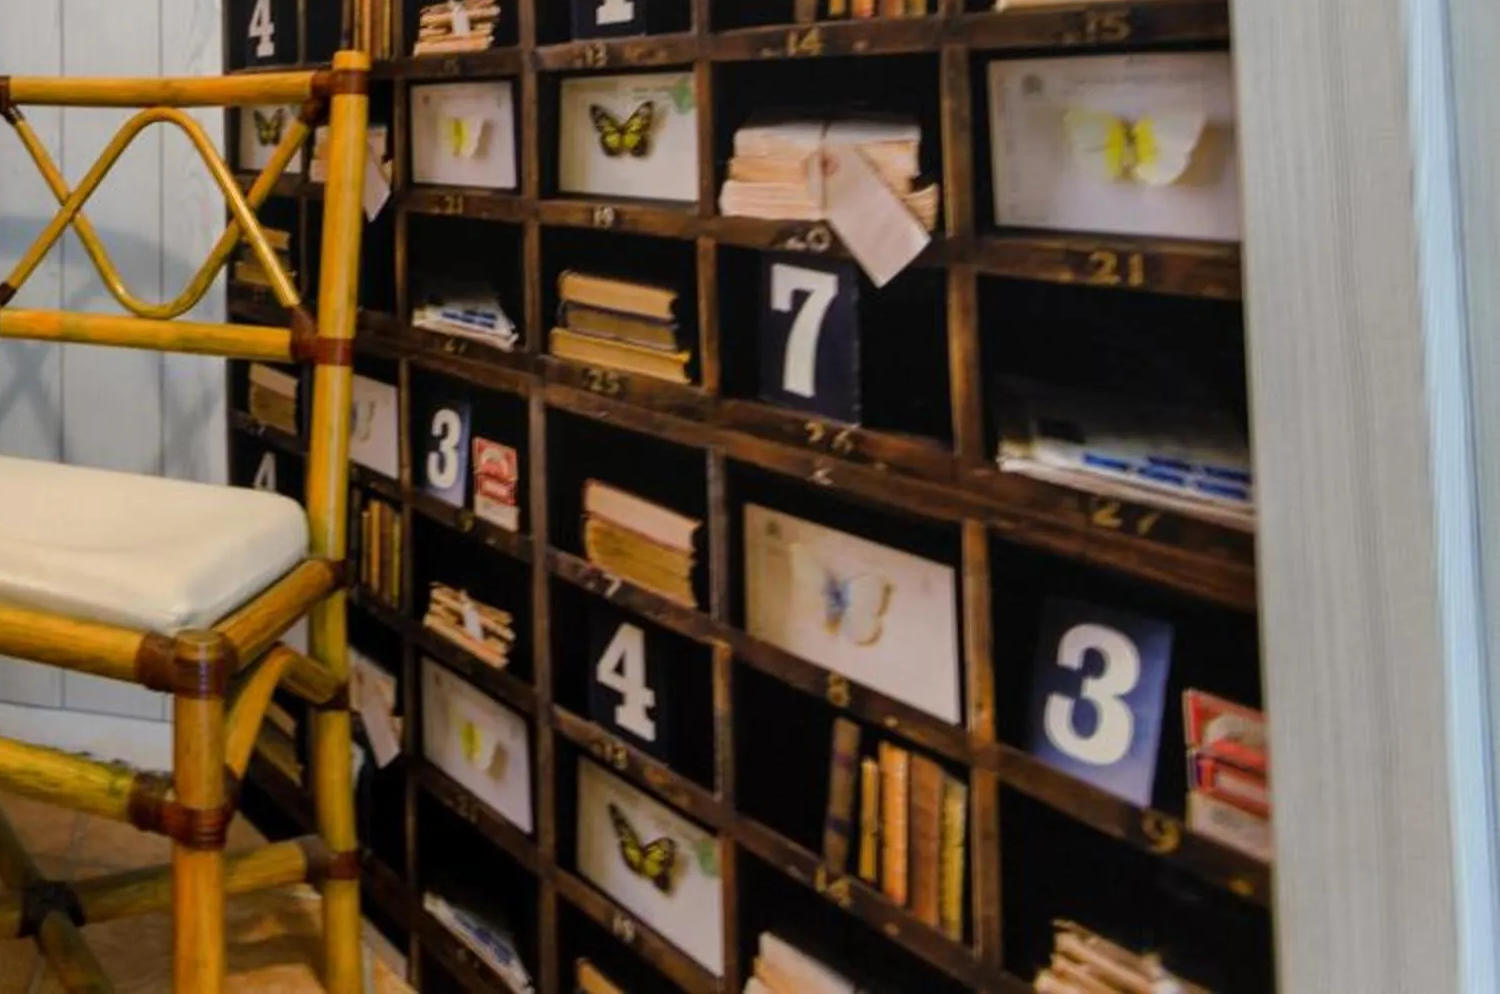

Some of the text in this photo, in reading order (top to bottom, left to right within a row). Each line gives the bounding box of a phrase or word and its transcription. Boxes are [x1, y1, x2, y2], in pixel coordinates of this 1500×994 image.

[787, 26, 825, 57] 14
[1085, 9, 1132, 42] 15
[1088, 250, 1145, 289] 21
[769, 262, 839, 399] 7
[426, 408, 463, 489] 3
[595, 621, 657, 743] 4
[825, 670, 851, 708] 8
[1043, 622, 1142, 766] 3
[1140, 808, 1181, 854] 9
